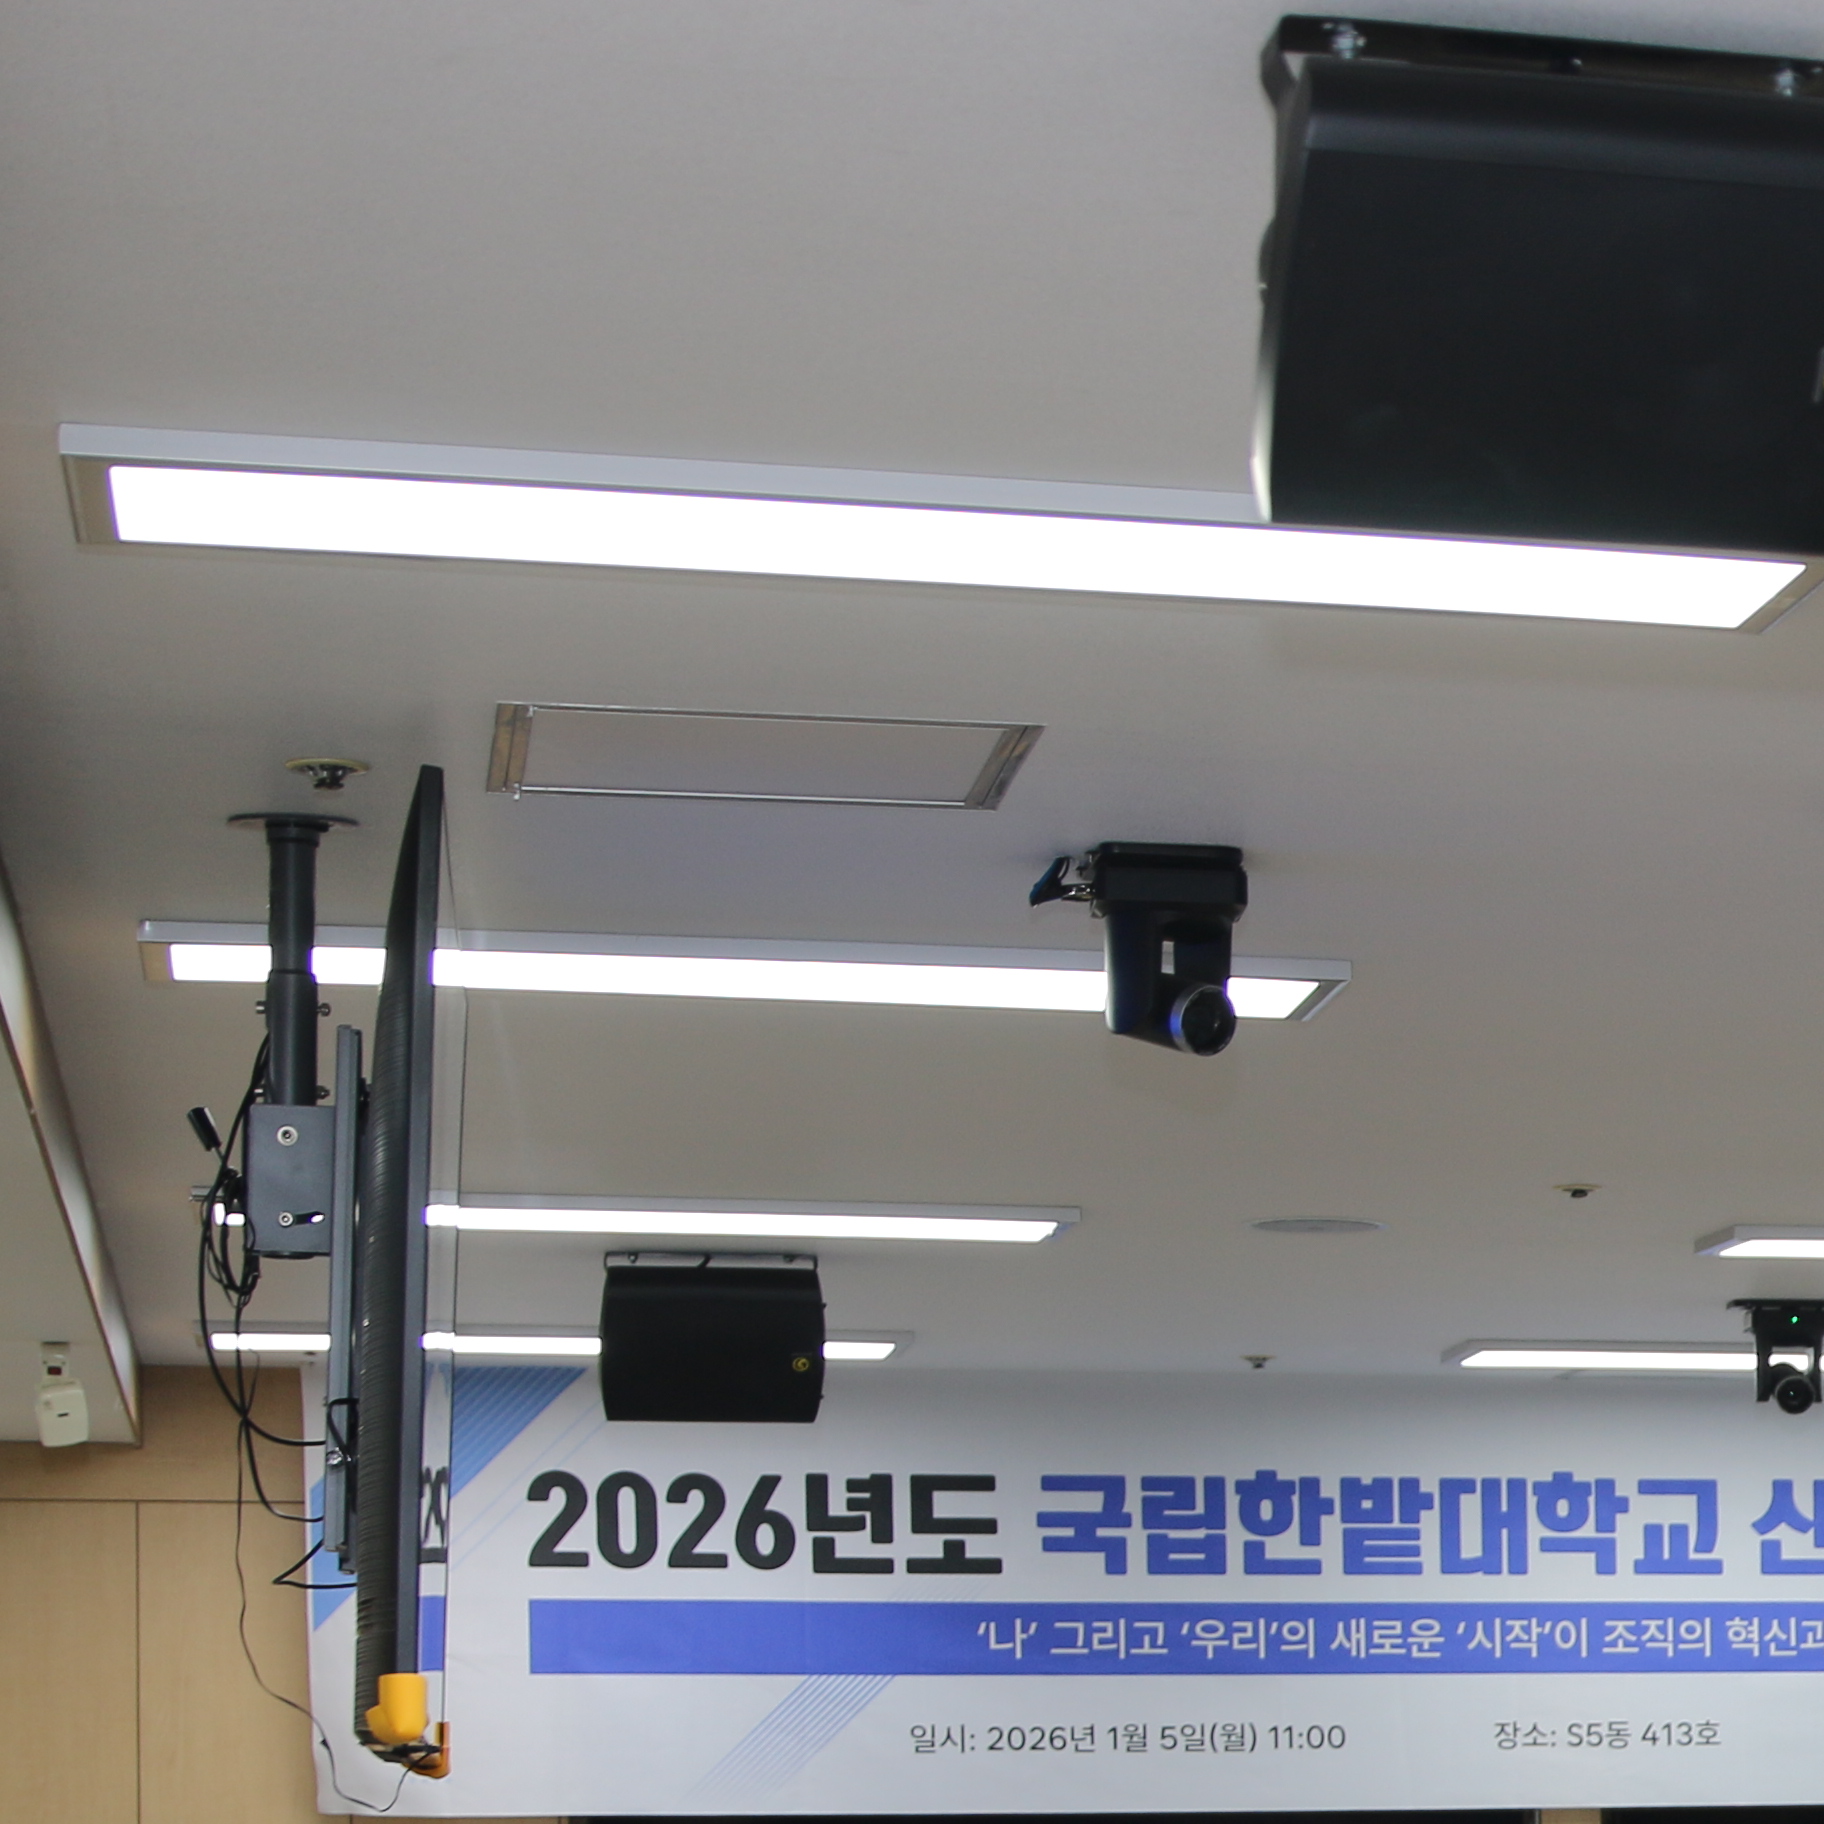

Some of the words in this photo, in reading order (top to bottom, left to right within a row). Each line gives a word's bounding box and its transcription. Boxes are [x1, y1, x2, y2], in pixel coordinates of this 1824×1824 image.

[526, 1470, 1002, 1575] 2026년도
[1037, 1470, 1723, 1575] 국립한밭대학교
[1050, 1618, 1168, 1659] 그리고
[1330, 1618, 1445, 1659] 새로운
[1602, 1617, 1712, 1658] 조직의
[910, 1724, 976, 1754] 일시:
[987, 1724, 1096, 1754] 2026년
[1108, 1724, 1149, 1753] 1월
[1161, 1723, 1257, 1754] 5일(월)
[1269, 1724, 1346, 1750] 11:00
[1494, 1721, 1557, 1751] 장소:
[1567, 1721, 1631, 1750] S5동
[1640, 1720, 1721, 1748] 413호
